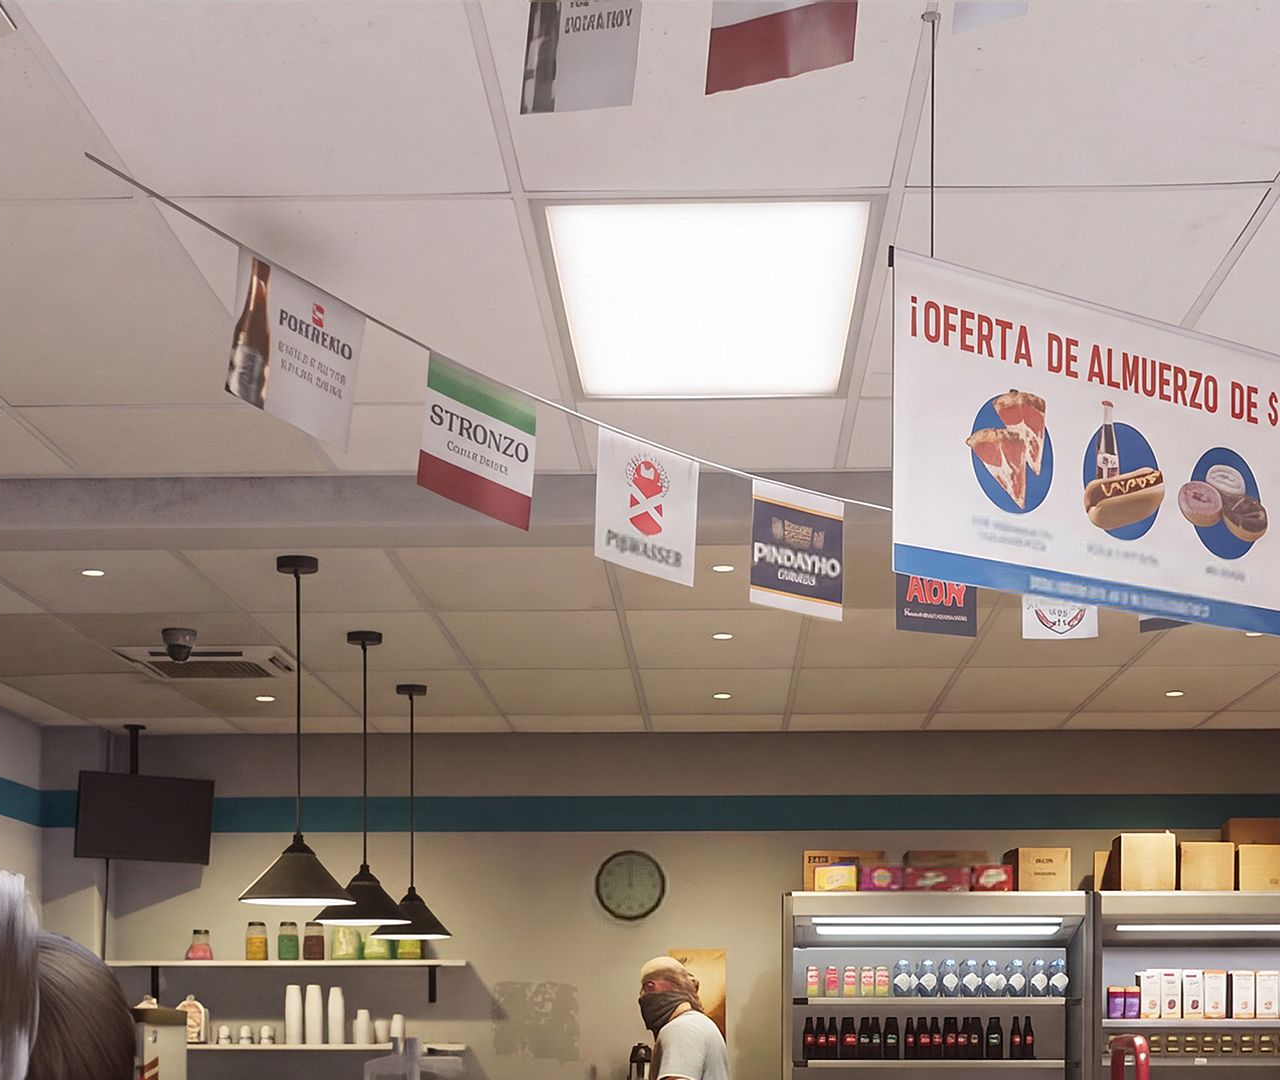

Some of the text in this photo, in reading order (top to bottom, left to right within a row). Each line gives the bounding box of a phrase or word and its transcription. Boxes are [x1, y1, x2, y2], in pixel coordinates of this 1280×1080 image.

[910, 296, 1032, 368] ¡OFERTA
[1047, 332, 1079, 379] DE
[1087, 344, 1218, 414] ALMUERZO
[1231, 381, 1259, 425] DE
[430, 403, 529, 463] STRONZO
